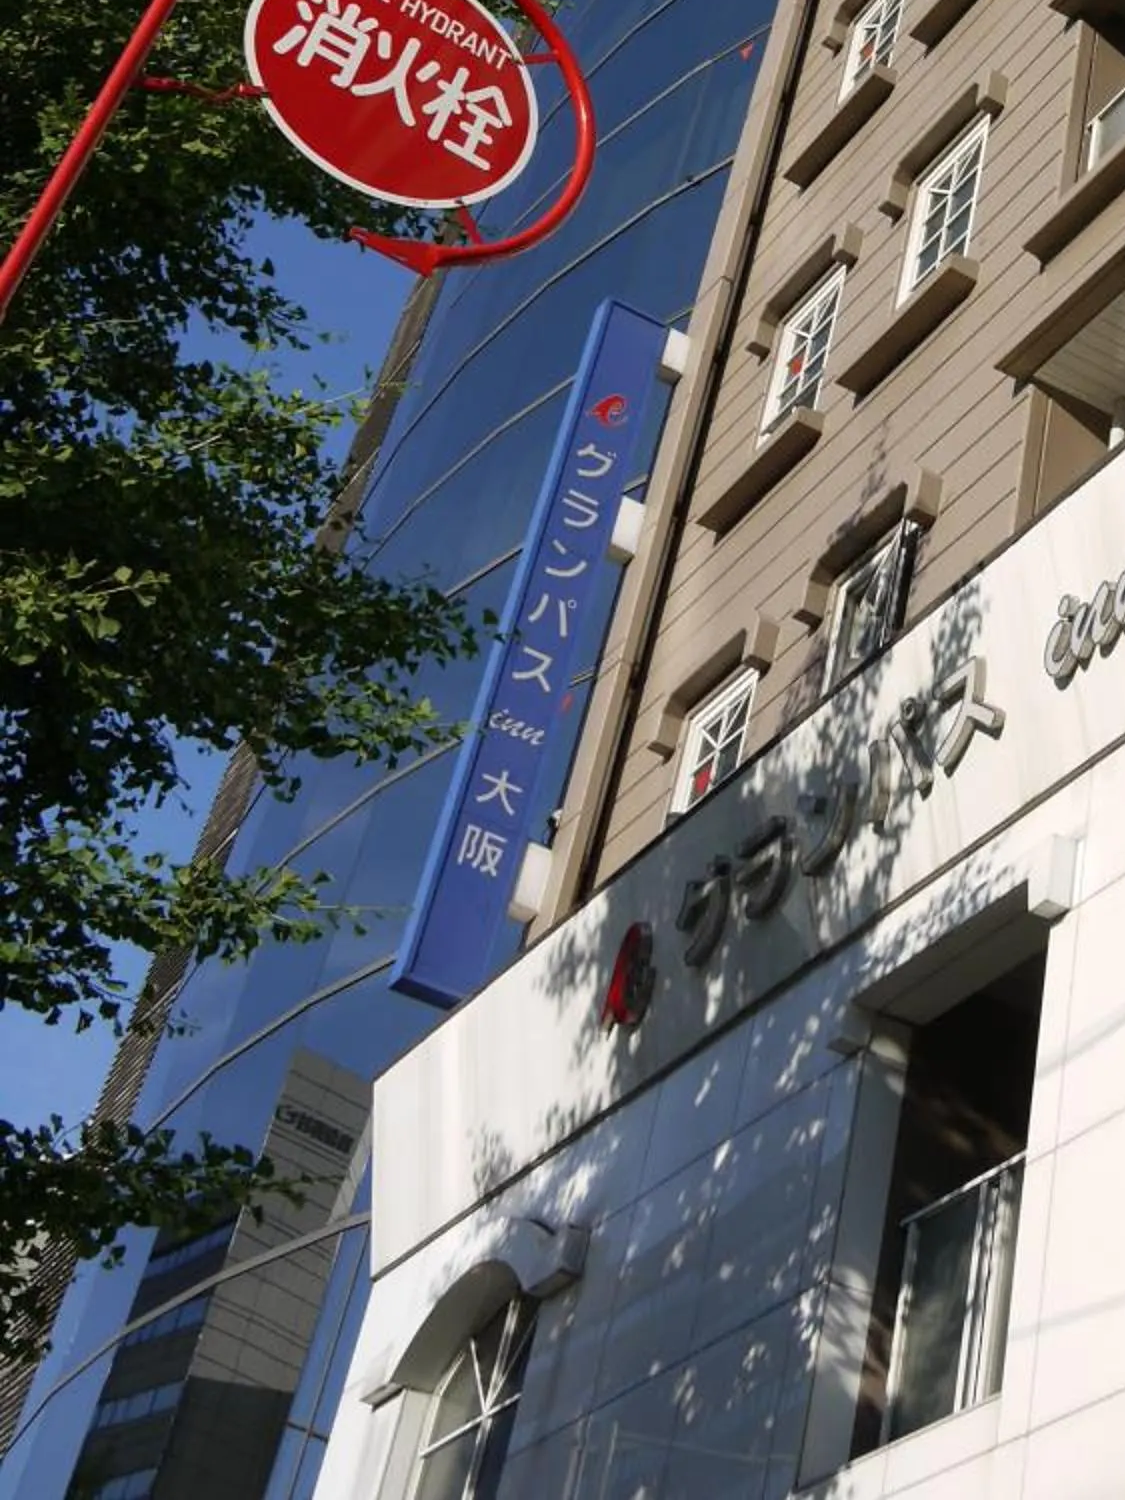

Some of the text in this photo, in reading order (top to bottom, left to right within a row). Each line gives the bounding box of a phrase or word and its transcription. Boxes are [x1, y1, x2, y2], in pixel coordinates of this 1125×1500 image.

[456, 442, 618, 878] グランパス inn 大阪
[674, 653, 1007, 970] グランパス
